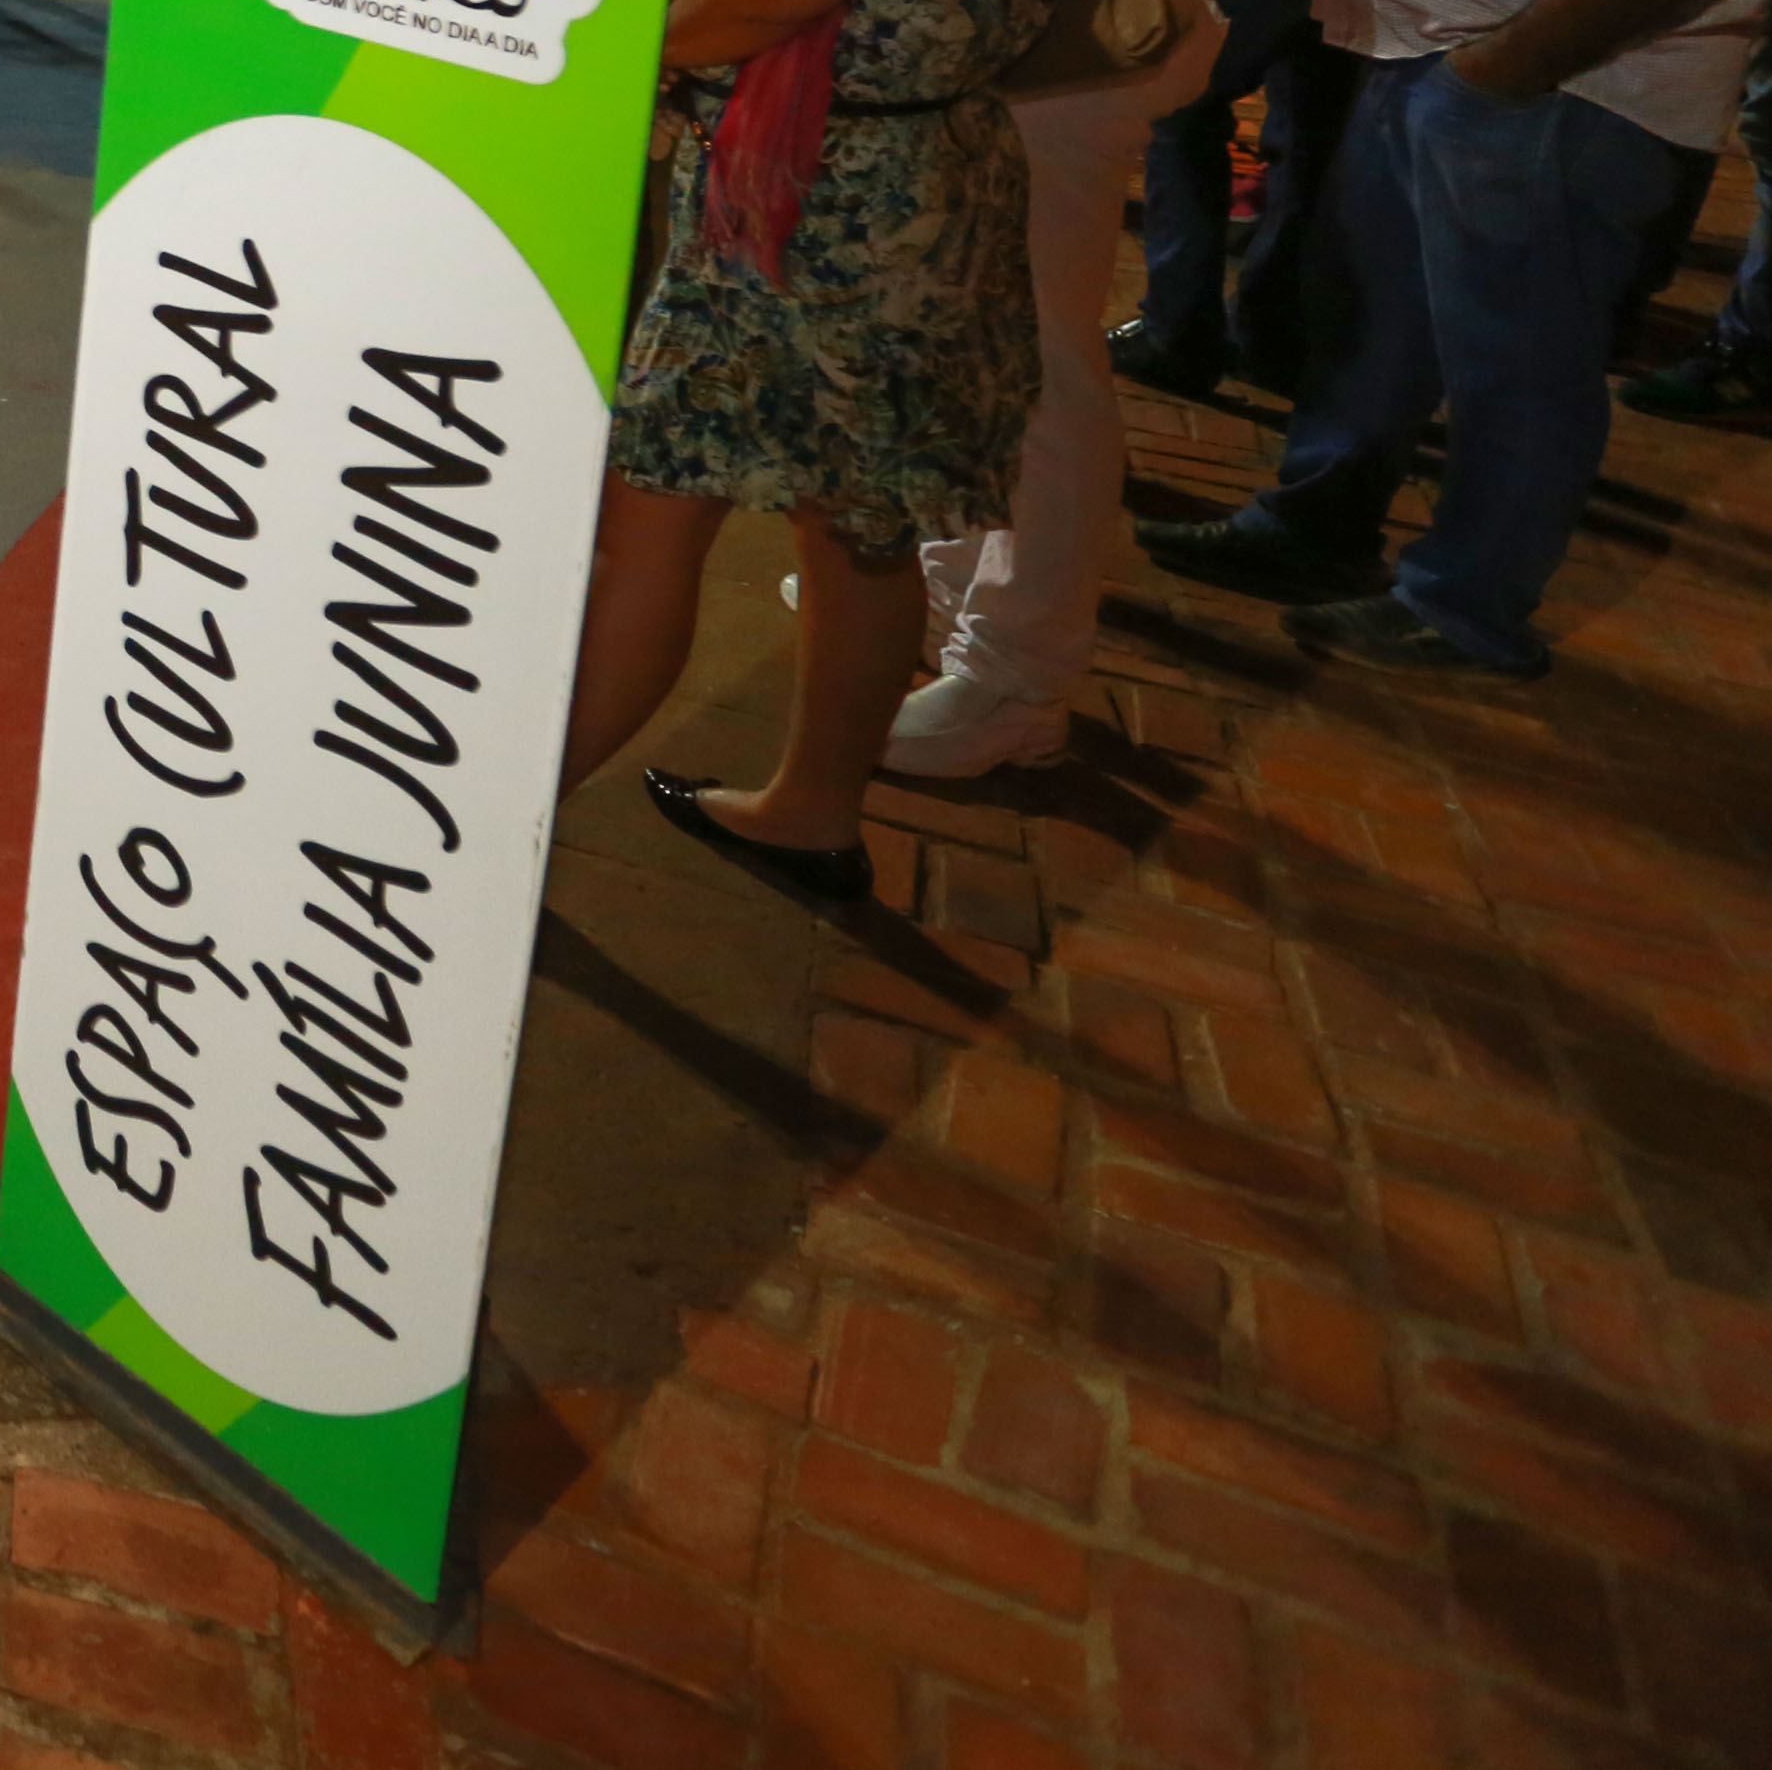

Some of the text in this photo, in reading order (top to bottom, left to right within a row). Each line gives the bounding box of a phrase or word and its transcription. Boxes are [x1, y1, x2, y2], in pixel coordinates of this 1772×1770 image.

[411, 12, 442, 34] NO
[447, 21, 482, 47] DIA
[483, 30, 499, 48] A
[503, 34, 539, 60] DIA
[65, 238, 278, 1212] ESPAÇO CULTURAL
[243, 346, 506, 1341] FAMÍLIA JUNINA
